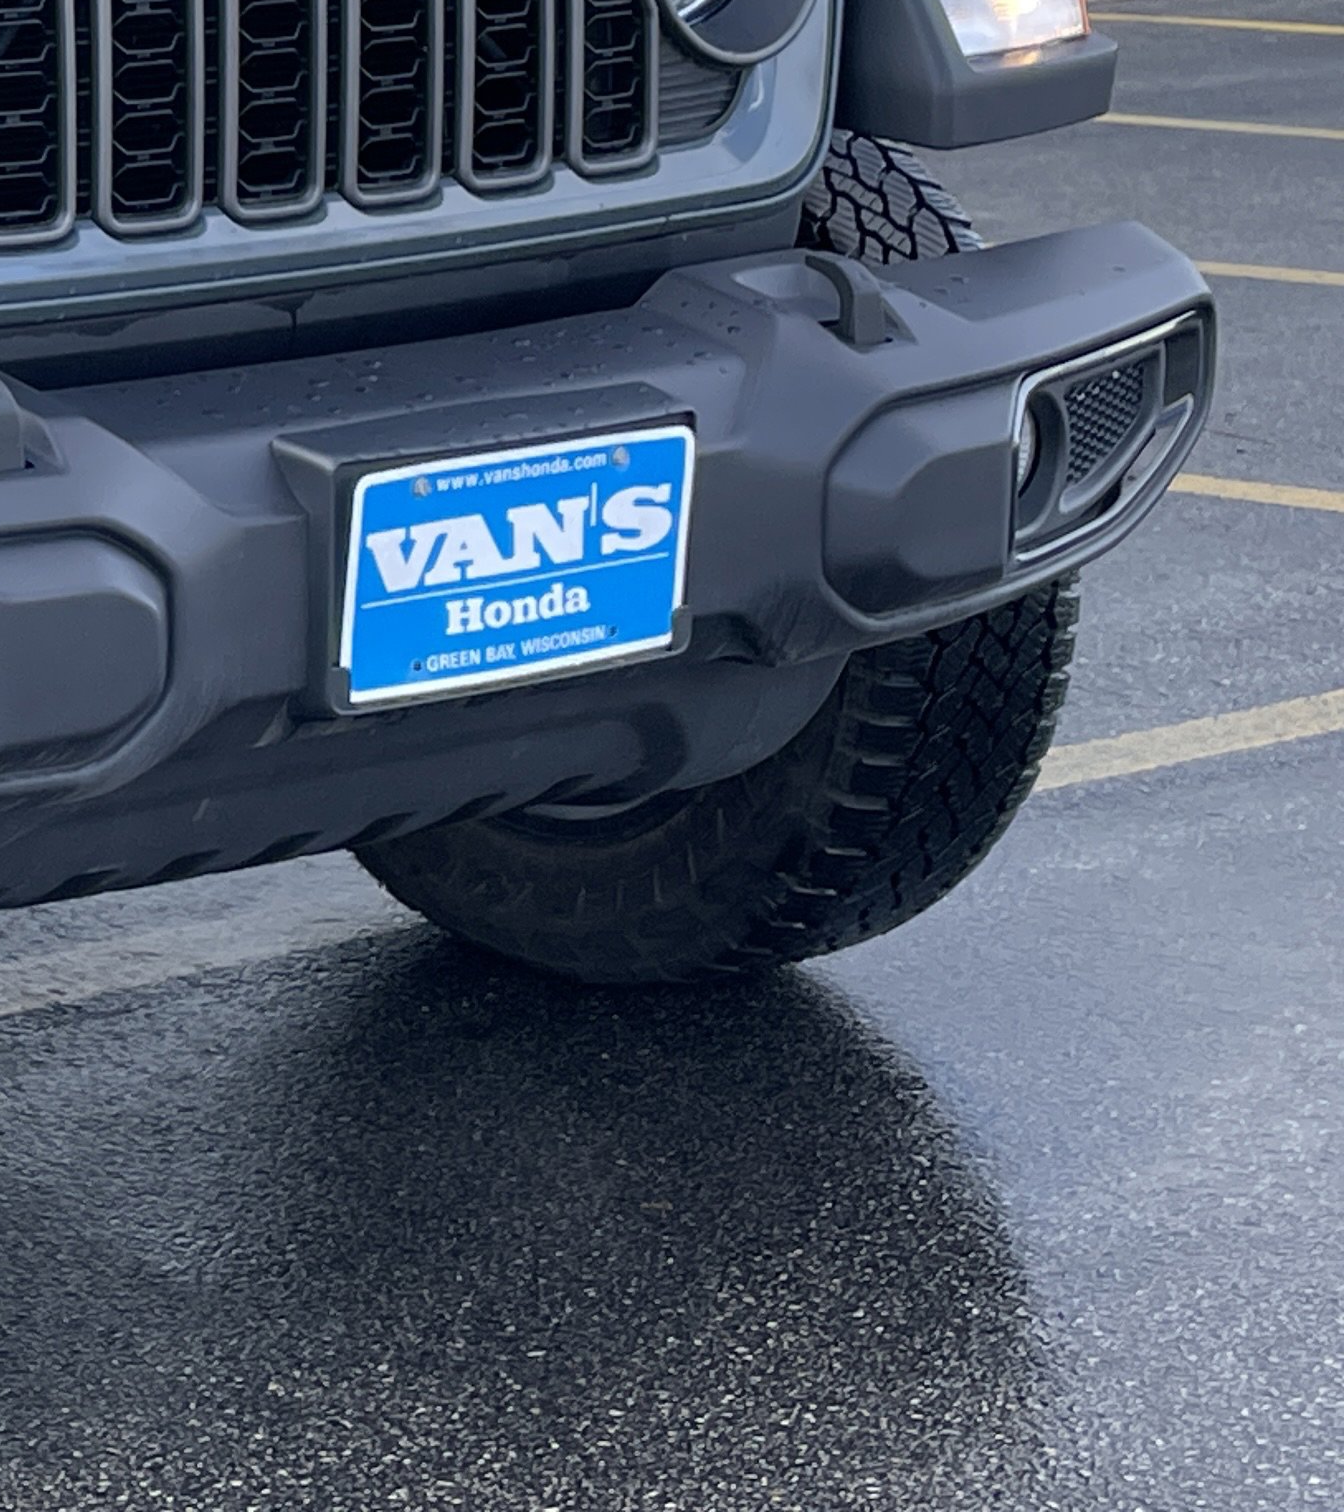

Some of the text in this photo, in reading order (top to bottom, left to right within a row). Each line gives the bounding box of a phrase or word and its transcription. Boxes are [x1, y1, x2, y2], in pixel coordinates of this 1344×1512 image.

[436, 452, 607, 492] www.vanshonda.com
[366, 482, 673, 594] VAN'S
[445, 582, 591, 635] Honda
[426, 649, 481, 673] GREEN
[521, 624, 607, 656] WISCONSIN
